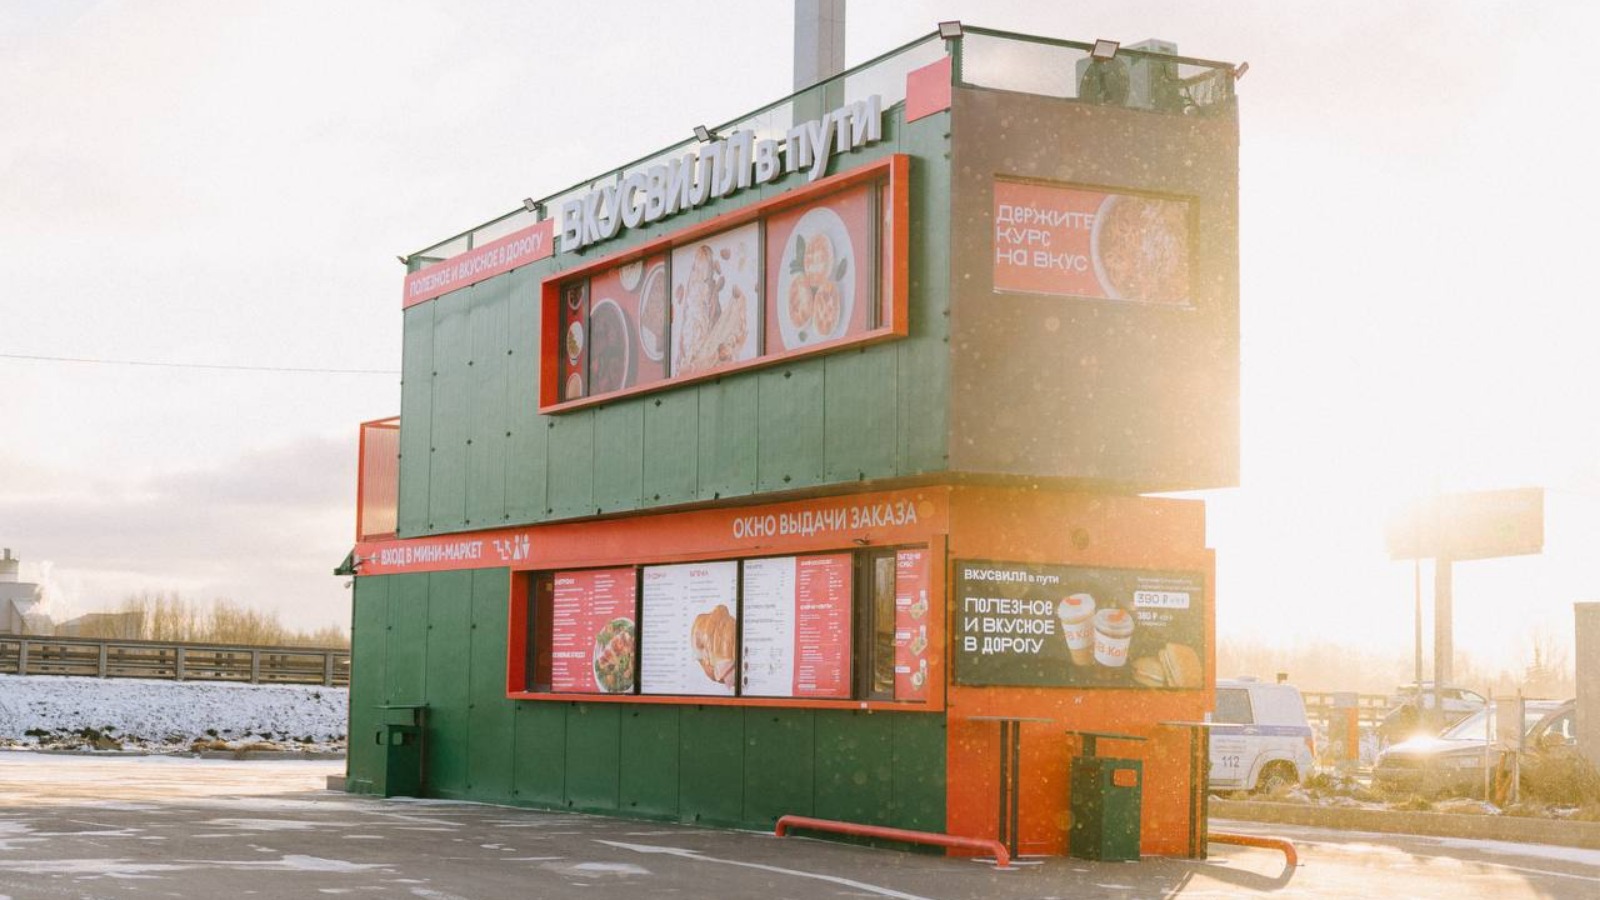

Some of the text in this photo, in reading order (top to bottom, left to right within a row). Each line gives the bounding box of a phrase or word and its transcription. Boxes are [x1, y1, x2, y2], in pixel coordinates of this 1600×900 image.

[561, 129, 754, 254] ВКУСВИЛЛ
[996, 226, 1051, 247] КУРС
[410, 232, 543, 296] ПОЛЕЗНОЕ И ВКУСНОЕ В ДОРОГУ
[1033, 250, 1089, 272] ВКУС
[733, 501, 918, 539] ОКНО ВЫДАЧИ ЗАКАЗА
[381, 540, 482, 567] ВХОД В МИНИ-МАРКЕТ
[964, 569, 1027, 581] ВКУСВИЛЛ
[964, 617, 979, 632] И
[983, 617, 1055, 635] ВКУСНОЕ
[964, 636, 1044, 655] В ДОРОГУ
[1221, 755, 1240, 768] 112
